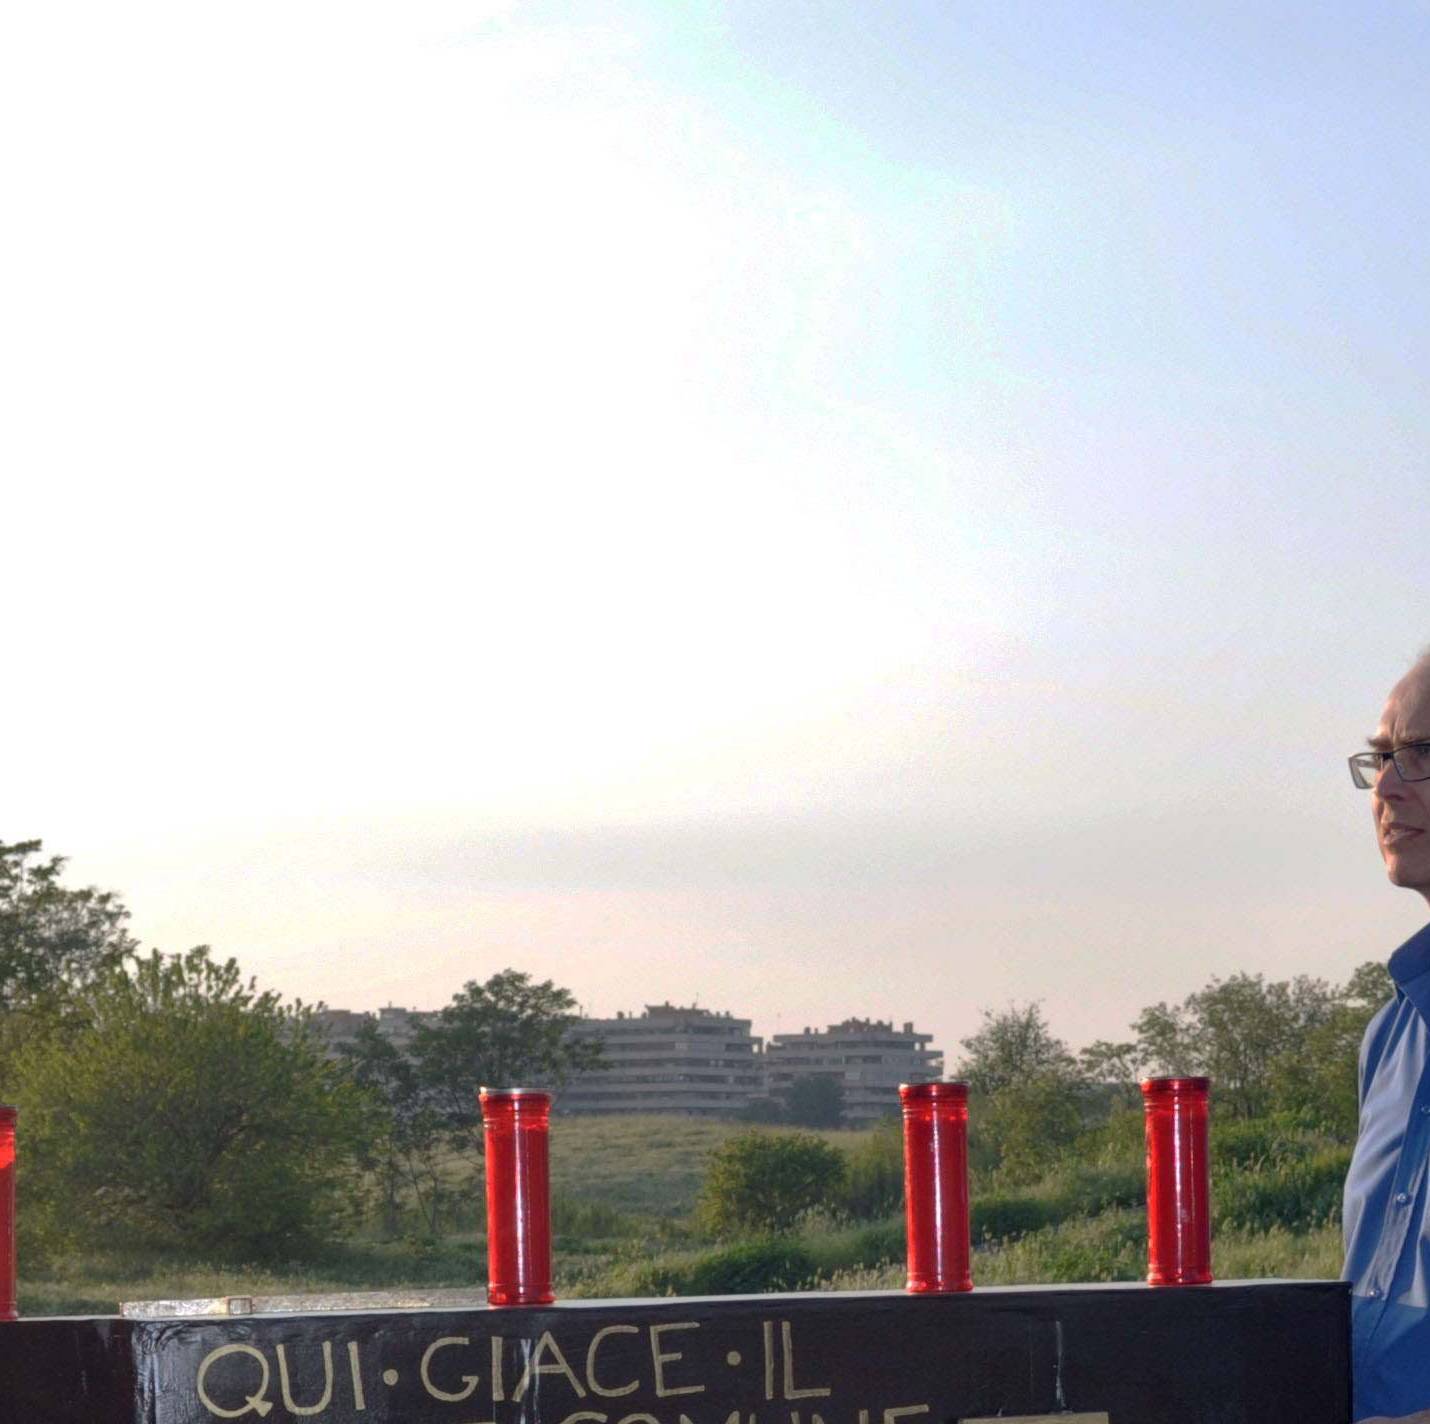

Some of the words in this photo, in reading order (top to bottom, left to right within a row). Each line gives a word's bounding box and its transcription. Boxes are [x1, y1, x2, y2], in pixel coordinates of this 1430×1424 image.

[196, 1340, 367, 1418] QUI
[420, 1322, 706, 1404] GIACE
[764, 1320, 831, 1400] IL
